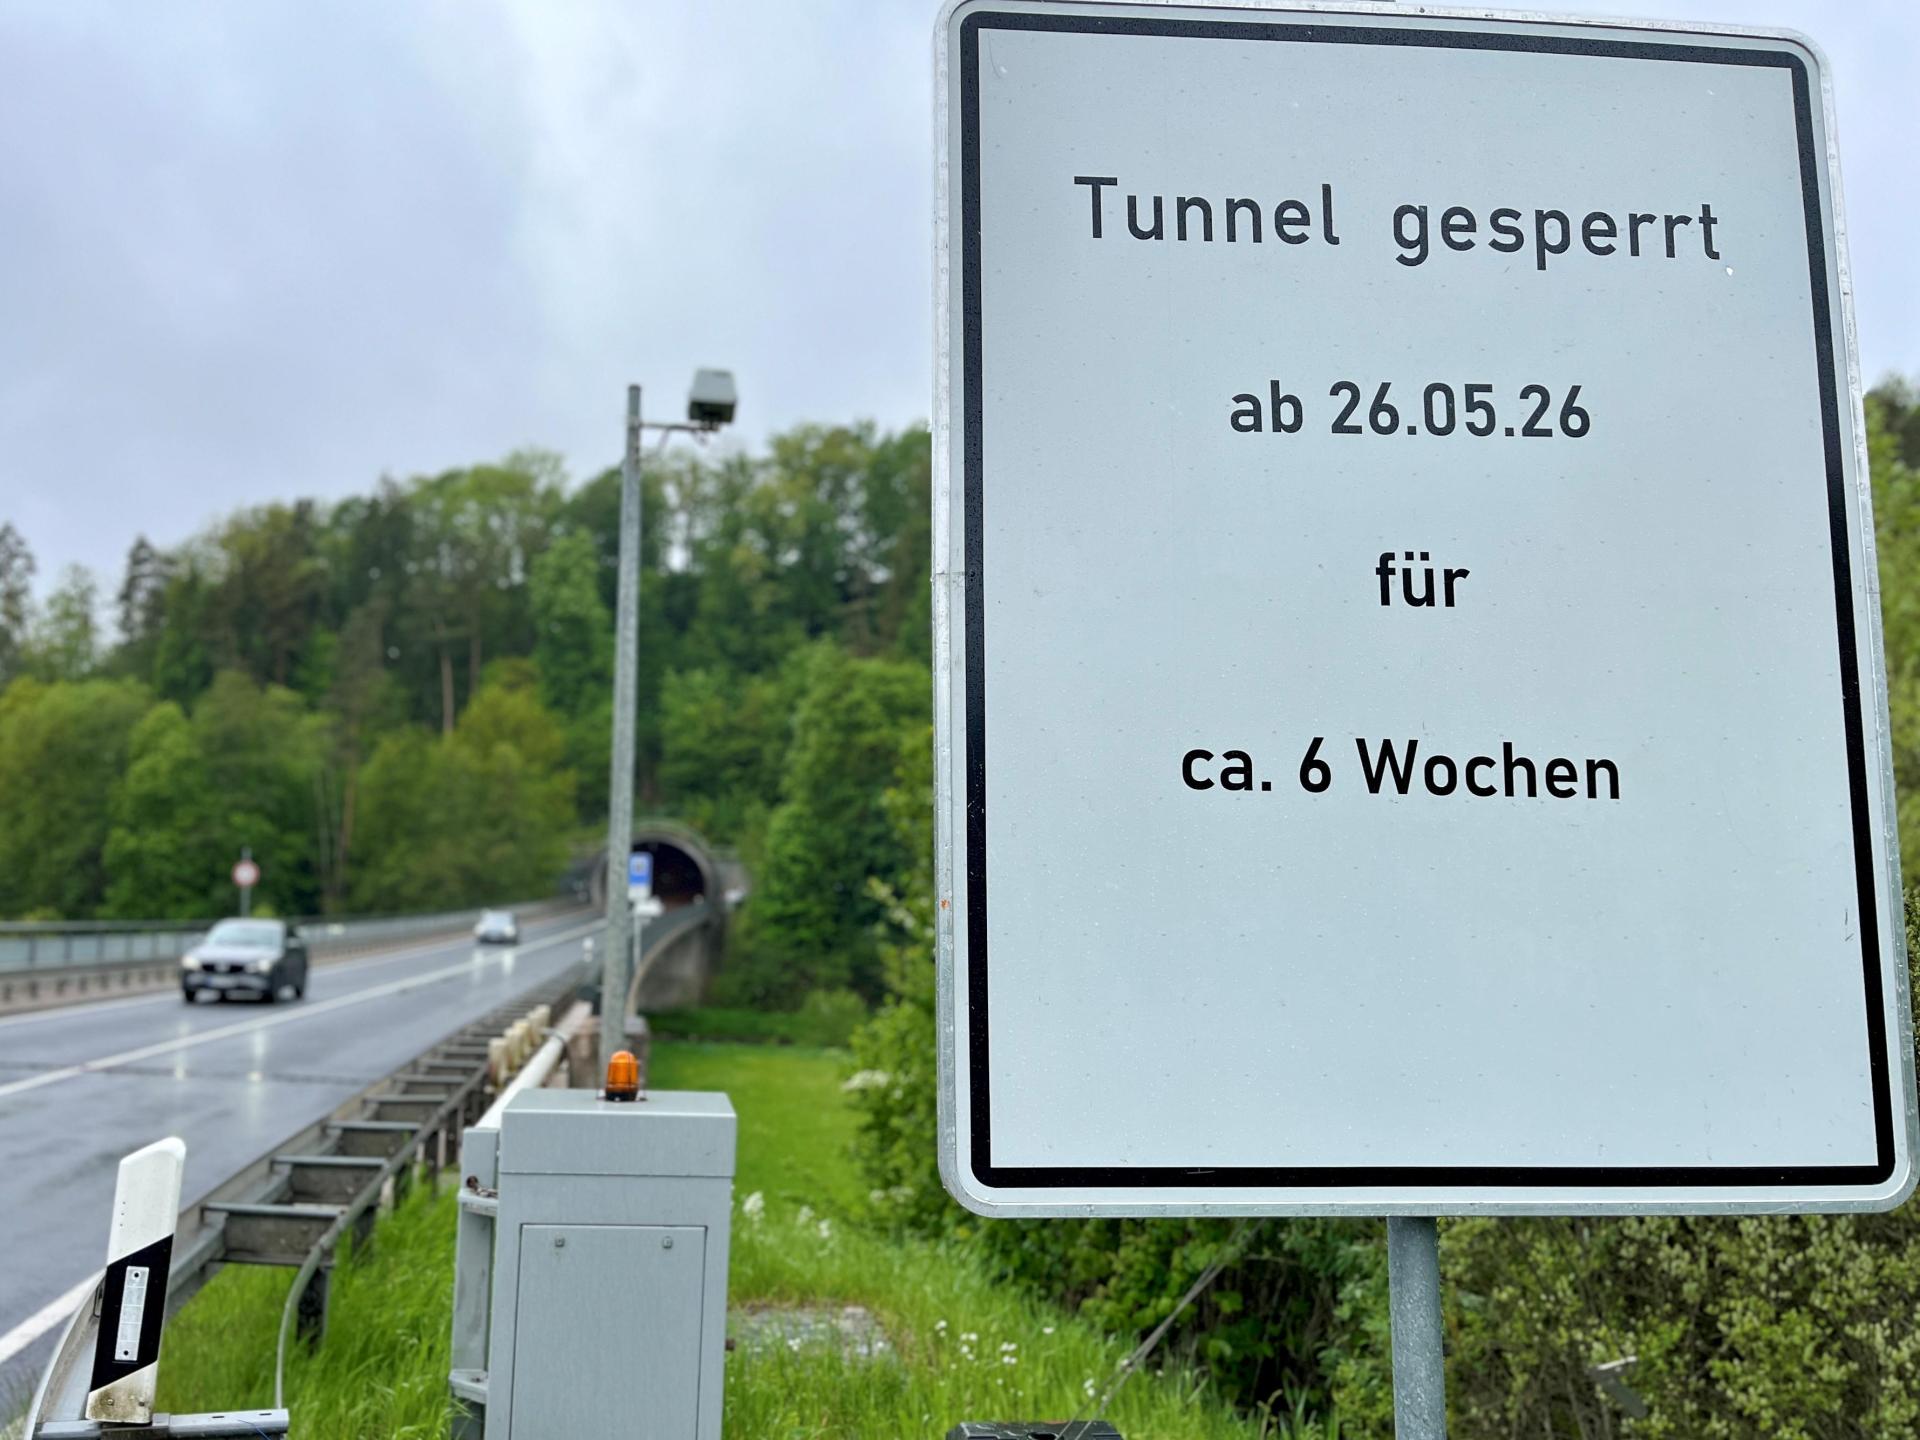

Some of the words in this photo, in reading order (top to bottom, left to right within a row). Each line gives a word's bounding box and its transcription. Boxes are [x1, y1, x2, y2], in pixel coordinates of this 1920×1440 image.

[1073, 175, 1341, 246] Tunnel
[1393, 203, 1721, 271] gesperrt
[1230, 379, 1303, 434] ab
[1329, 380, 1591, 438] 26.05.26
[1375, 551, 1471, 608] für
[1181, 748, 1272, 792] ca.
[1299, 736, 1332, 794] 6
[1355, 737, 1620, 800] Wochen
